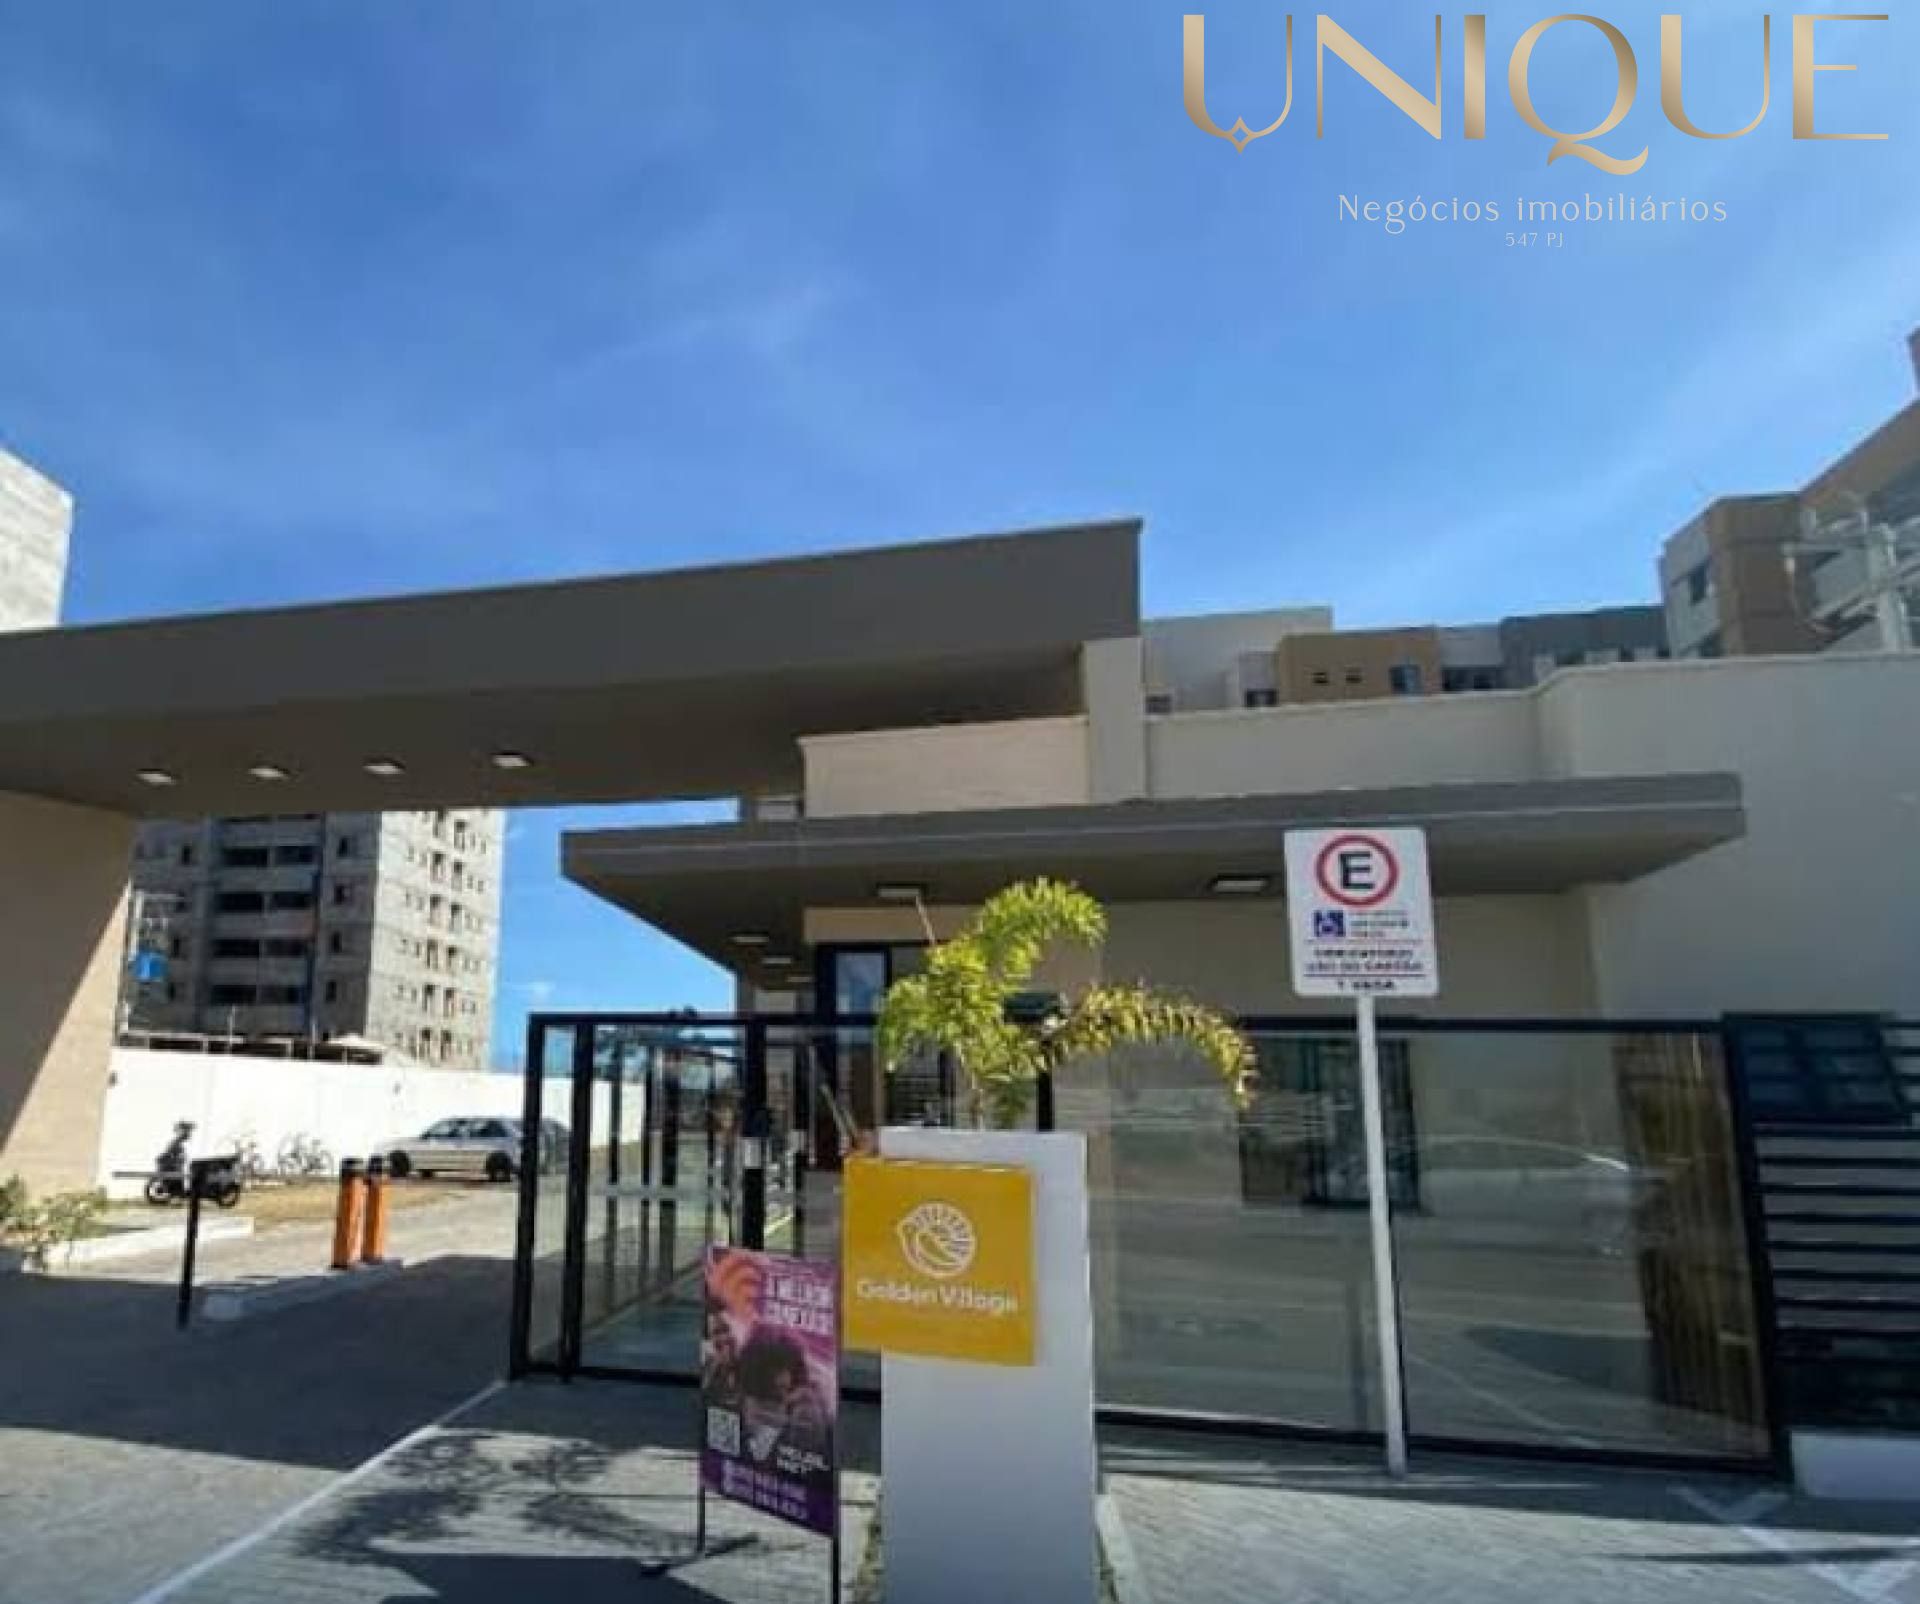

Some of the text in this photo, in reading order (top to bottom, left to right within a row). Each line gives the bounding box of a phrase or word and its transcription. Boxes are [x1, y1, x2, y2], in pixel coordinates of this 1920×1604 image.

[1339, 850, 1375, 890] E
[856, 1278, 1018, 1318] Golden Village
